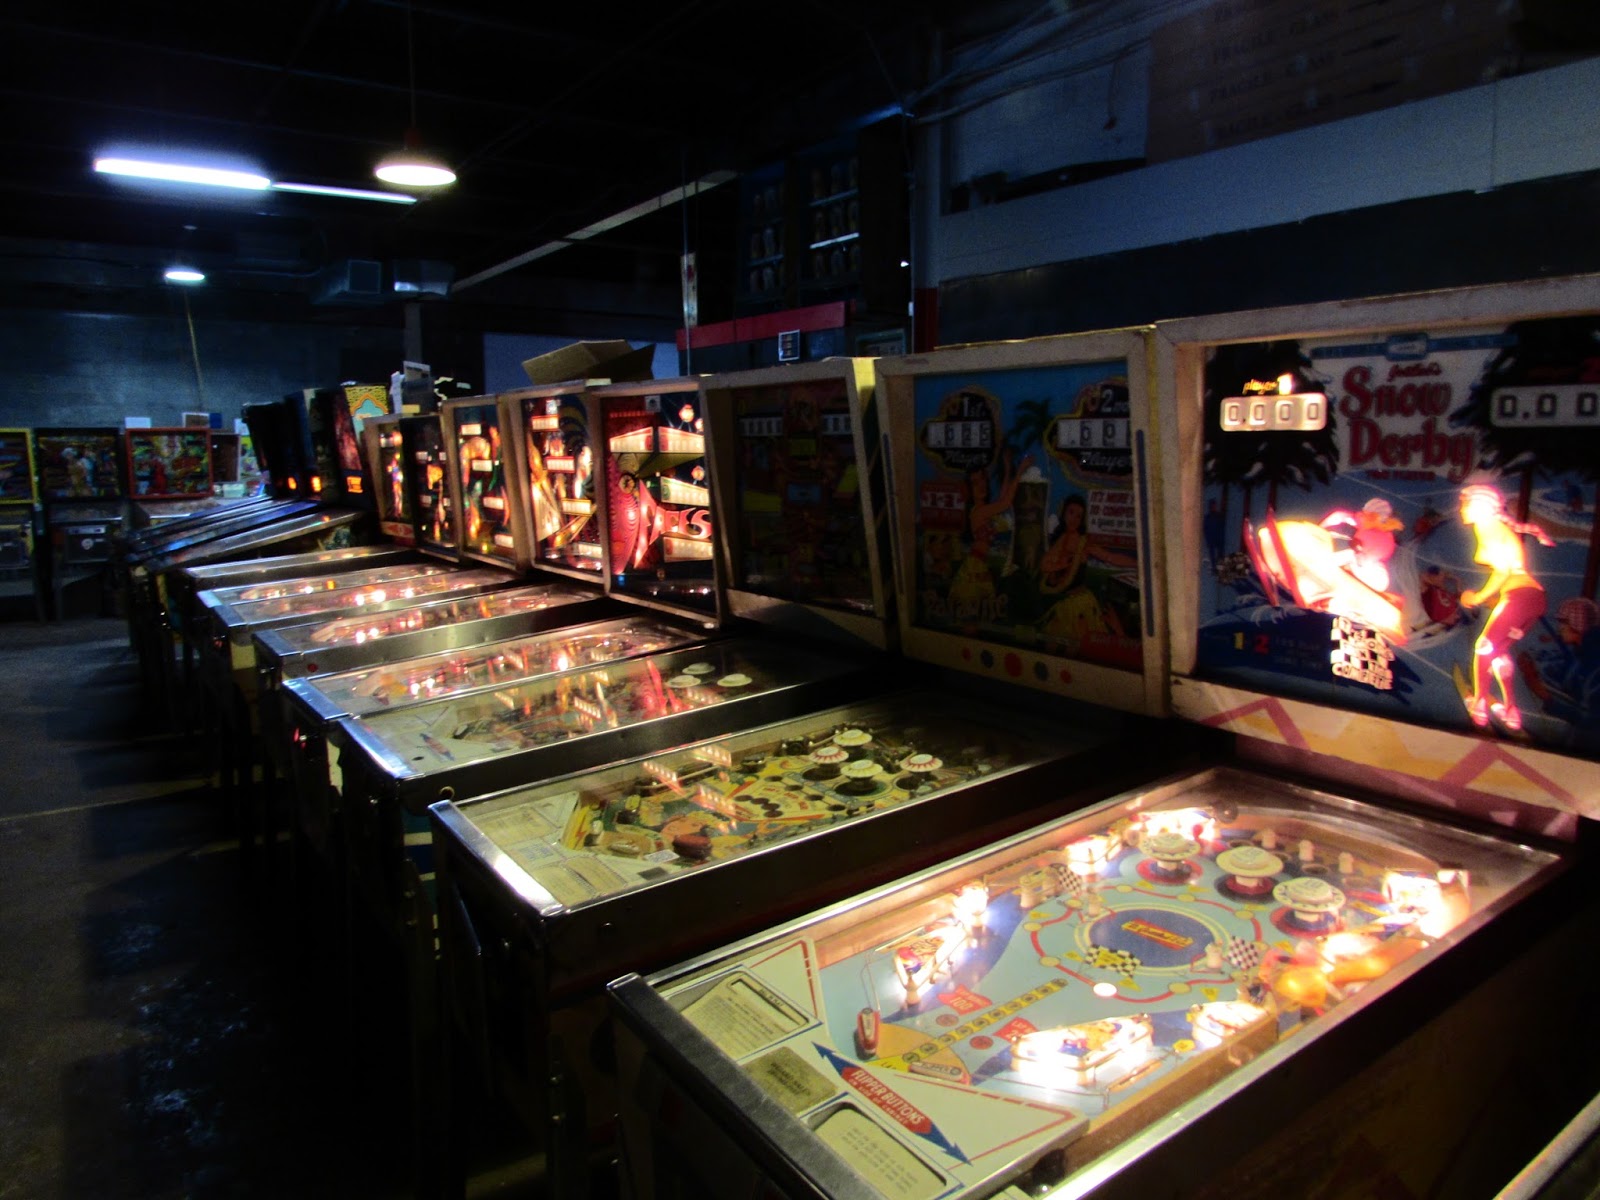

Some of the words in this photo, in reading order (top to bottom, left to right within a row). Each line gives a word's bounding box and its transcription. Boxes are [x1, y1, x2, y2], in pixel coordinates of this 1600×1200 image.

[1339, 364, 1452, 419] Snow
[1080, 451, 1130, 472] Playe
[1347, 415, 1475, 485] Derby
[851, 1069, 887, 1097] FLIPPER
[881, 1091, 926, 1125] BUTTONS
